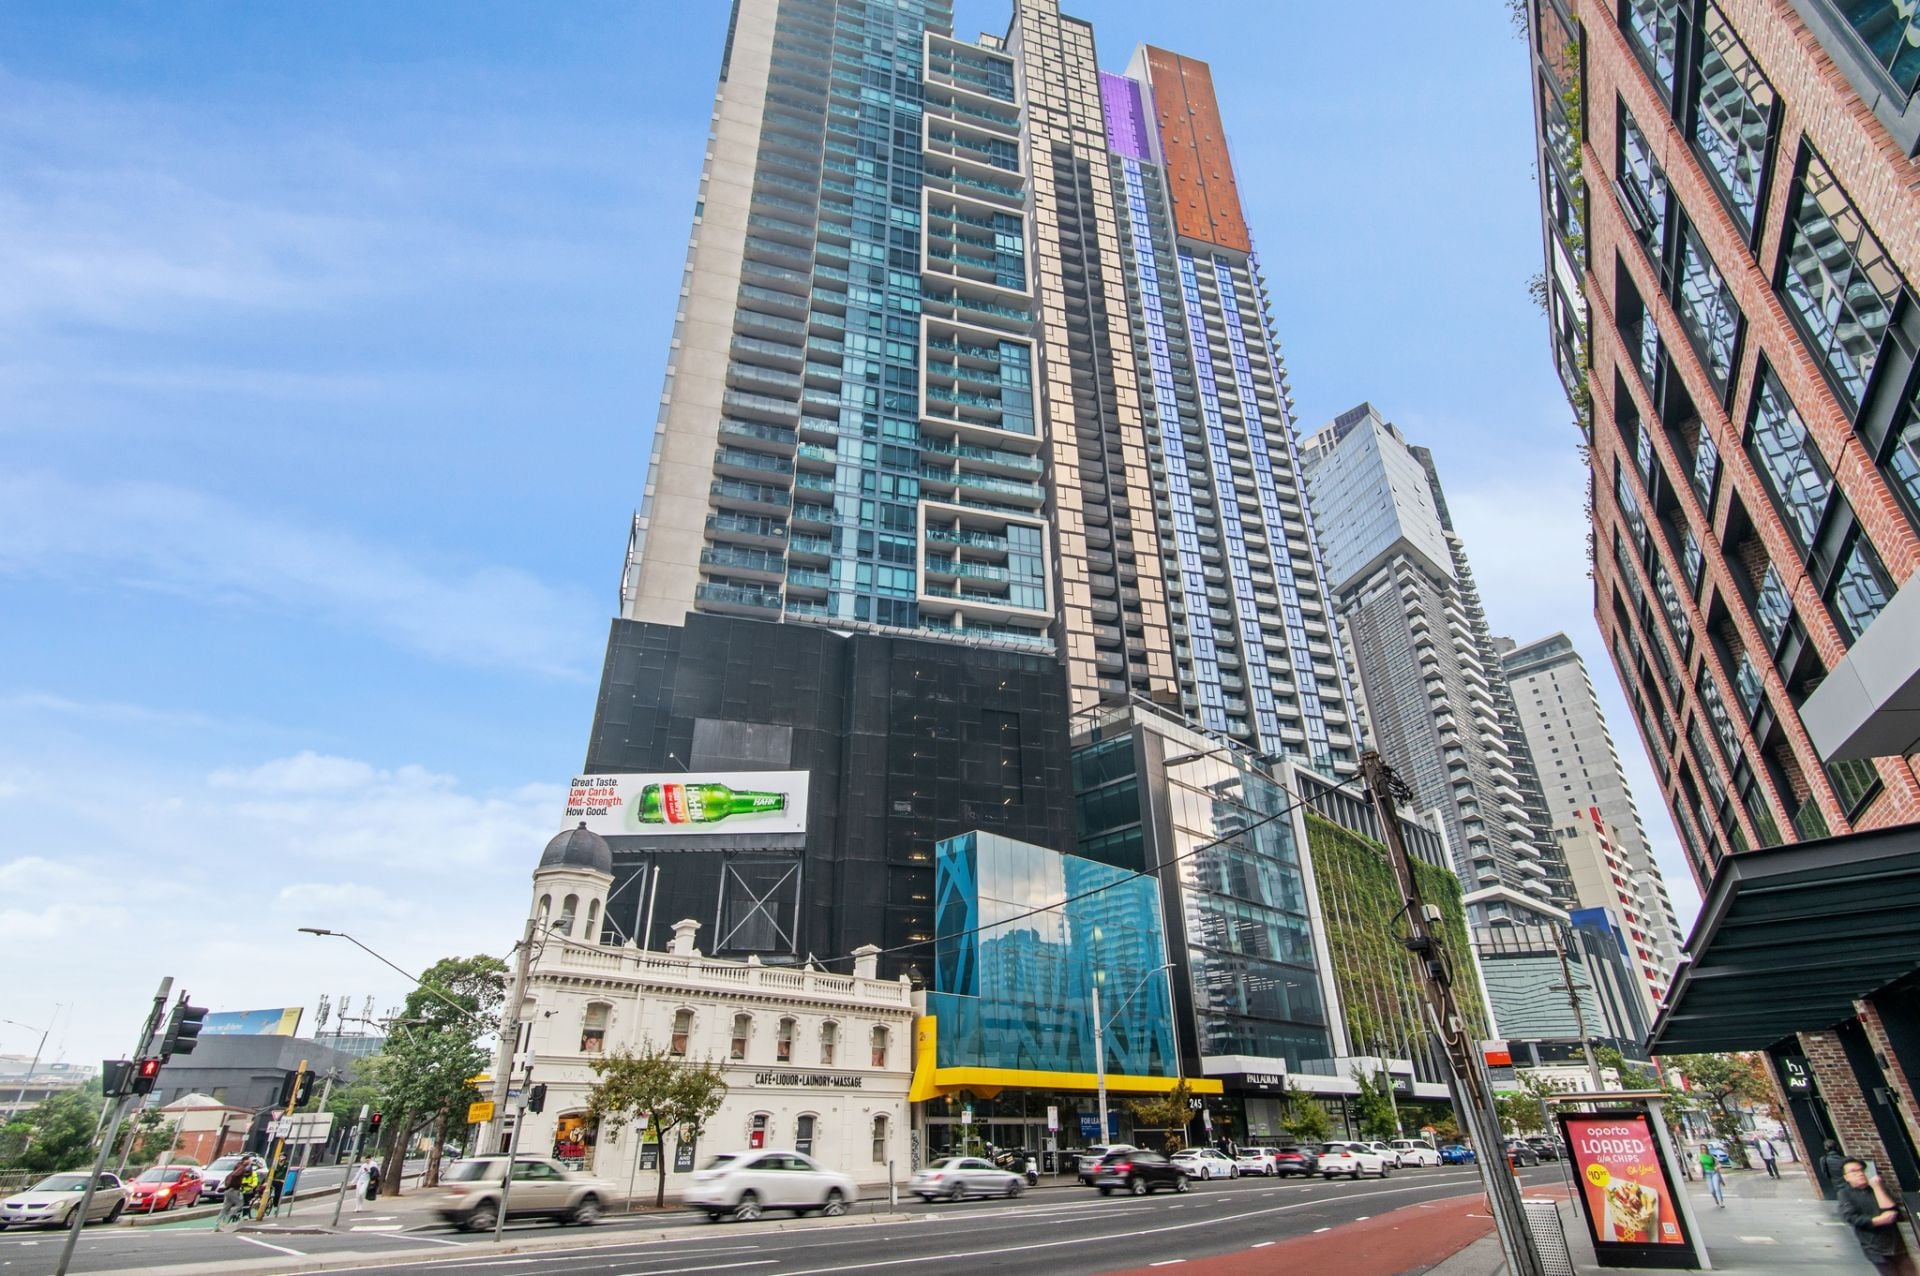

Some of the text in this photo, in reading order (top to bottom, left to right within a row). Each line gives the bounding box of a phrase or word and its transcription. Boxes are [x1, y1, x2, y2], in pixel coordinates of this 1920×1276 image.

[571, 778, 618, 787] Great Taste.
[569, 787, 615, 797] Low Carb &
[567, 797, 624, 807] Mid-Strength.
[753, 798, 776, 806] HAHN
[565, 807, 608, 816] How Good.
[1246, 1073, 1279, 1085] PALLADIUM
[1189, 1099, 1202, 1109] 245
[1080, 1117, 1091, 1125] FOR
[1587, 1126, 1629, 1137] oporto
[1581, 1139, 1646, 1154] LOADED
[1613, 1154, 1640, 1163] CHIPS
